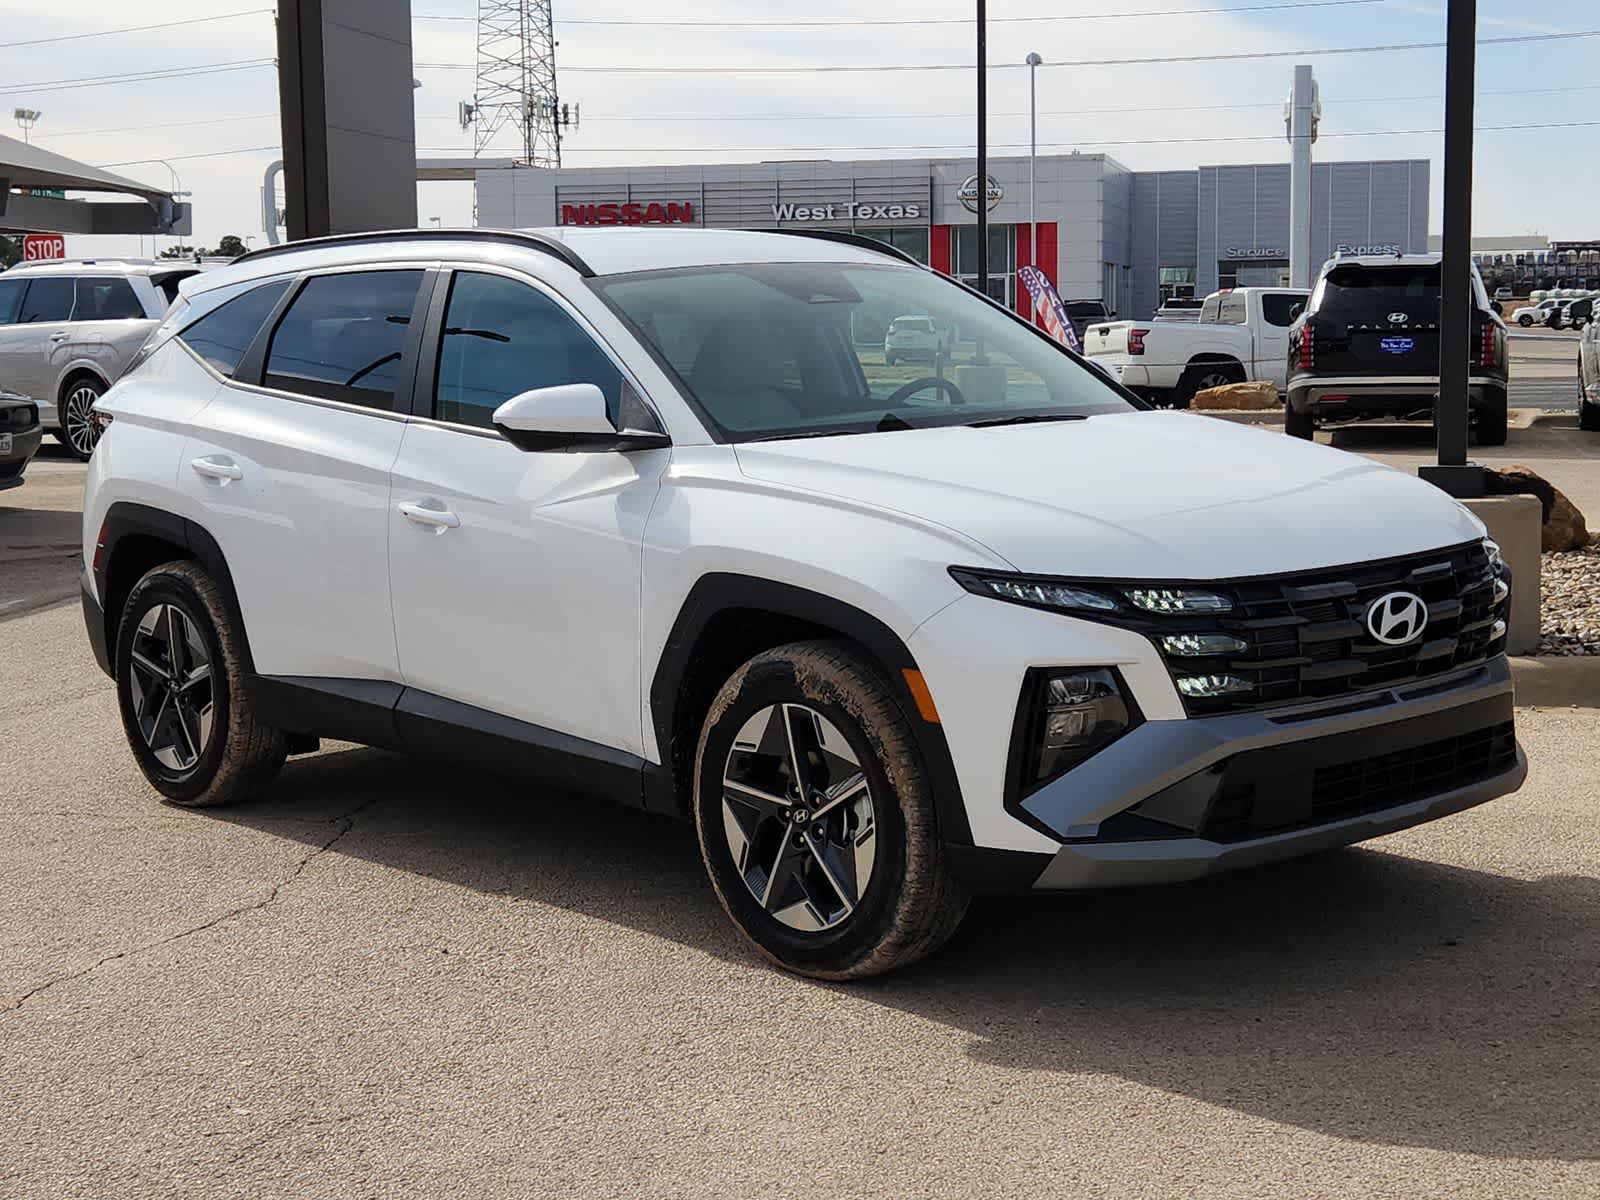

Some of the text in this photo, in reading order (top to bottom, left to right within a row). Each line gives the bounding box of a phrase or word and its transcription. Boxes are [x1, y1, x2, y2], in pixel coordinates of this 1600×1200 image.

[562, 203, 693, 225] NISSAN
[771, 202, 920, 221] West Texas
[27, 239, 63, 260] STOP
[1226, 244, 1401, 257] Service Express
